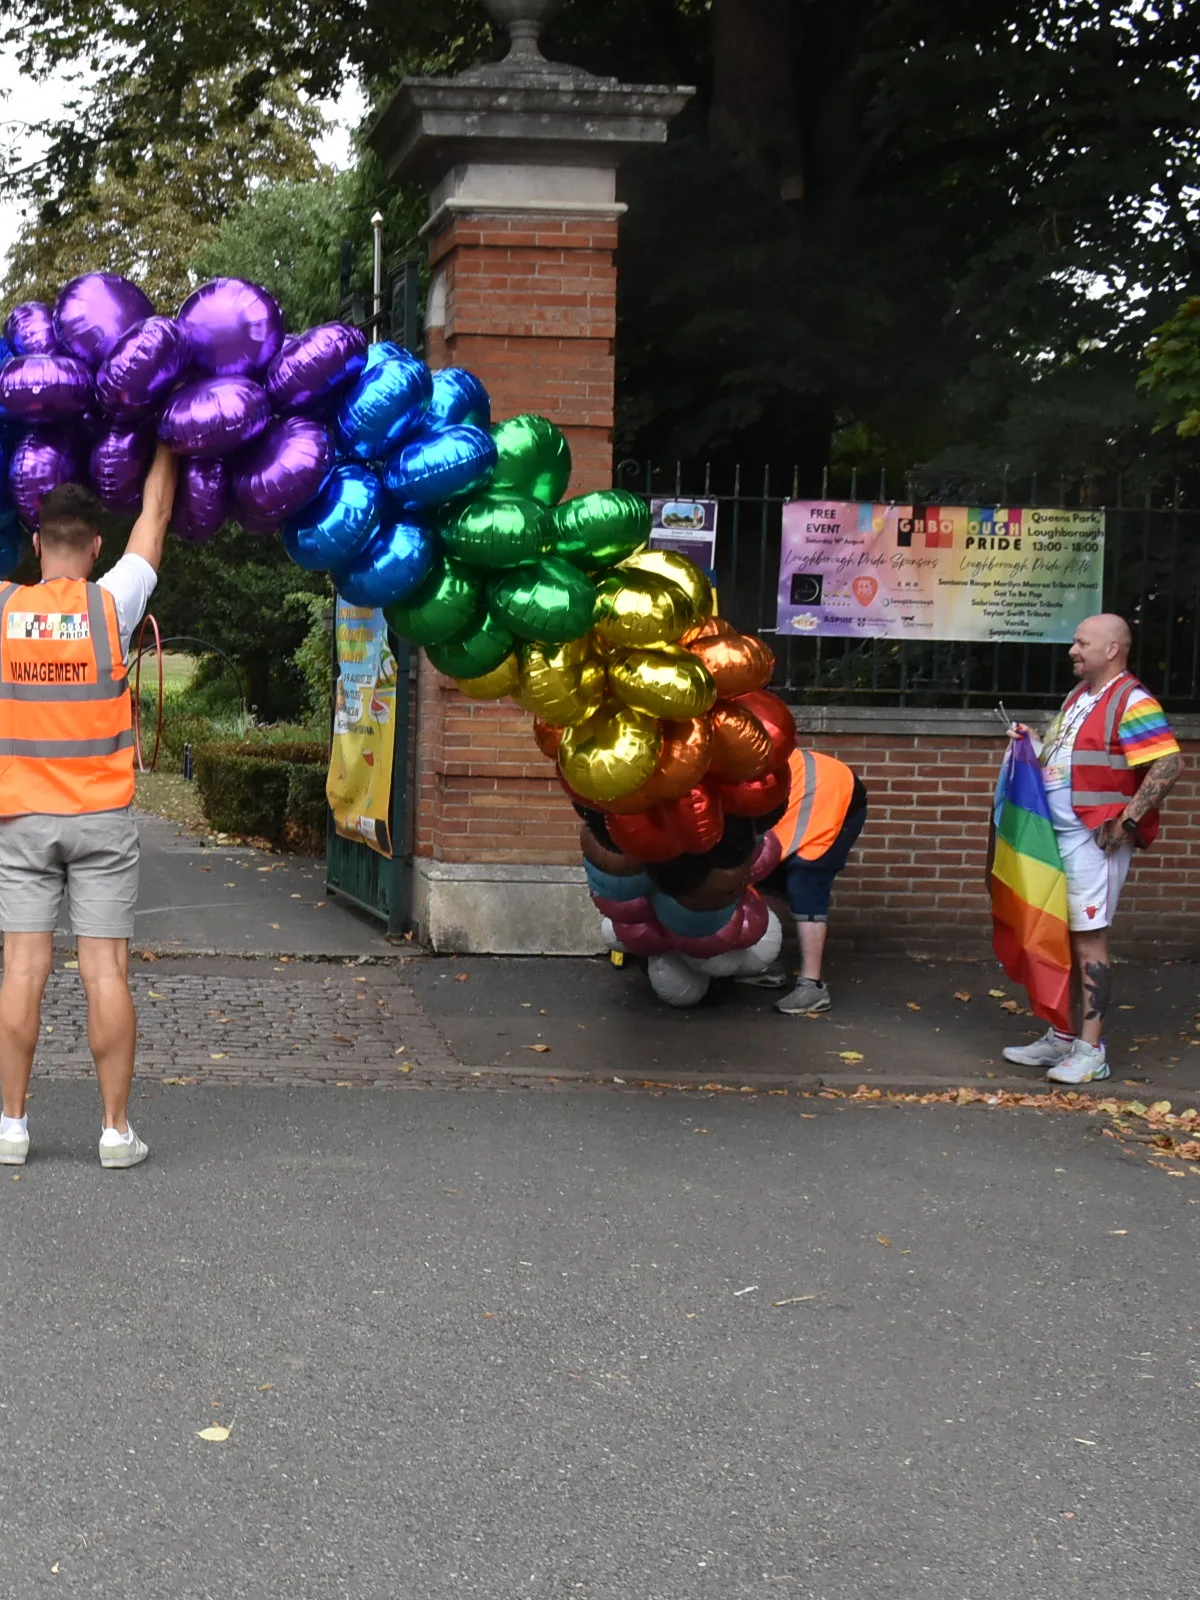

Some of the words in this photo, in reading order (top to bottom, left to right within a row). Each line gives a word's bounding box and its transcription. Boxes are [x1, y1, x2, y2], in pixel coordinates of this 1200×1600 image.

[810, 509, 837, 519] FREE
[1031, 512, 1071, 524] Queens
[806, 524, 841, 534] EVENT
[1027, 527, 1105, 540] Loughborough
[965, 536, 1022, 551] PRIDE
[1033, 542, 1062, 552] 13:00
[1071, 542, 1099, 553] 18:00
[856, 552, 888, 568] Pride
[60, 630, 88, 639] PRIDE
[11, 661, 88, 682] MANAGEMENT
